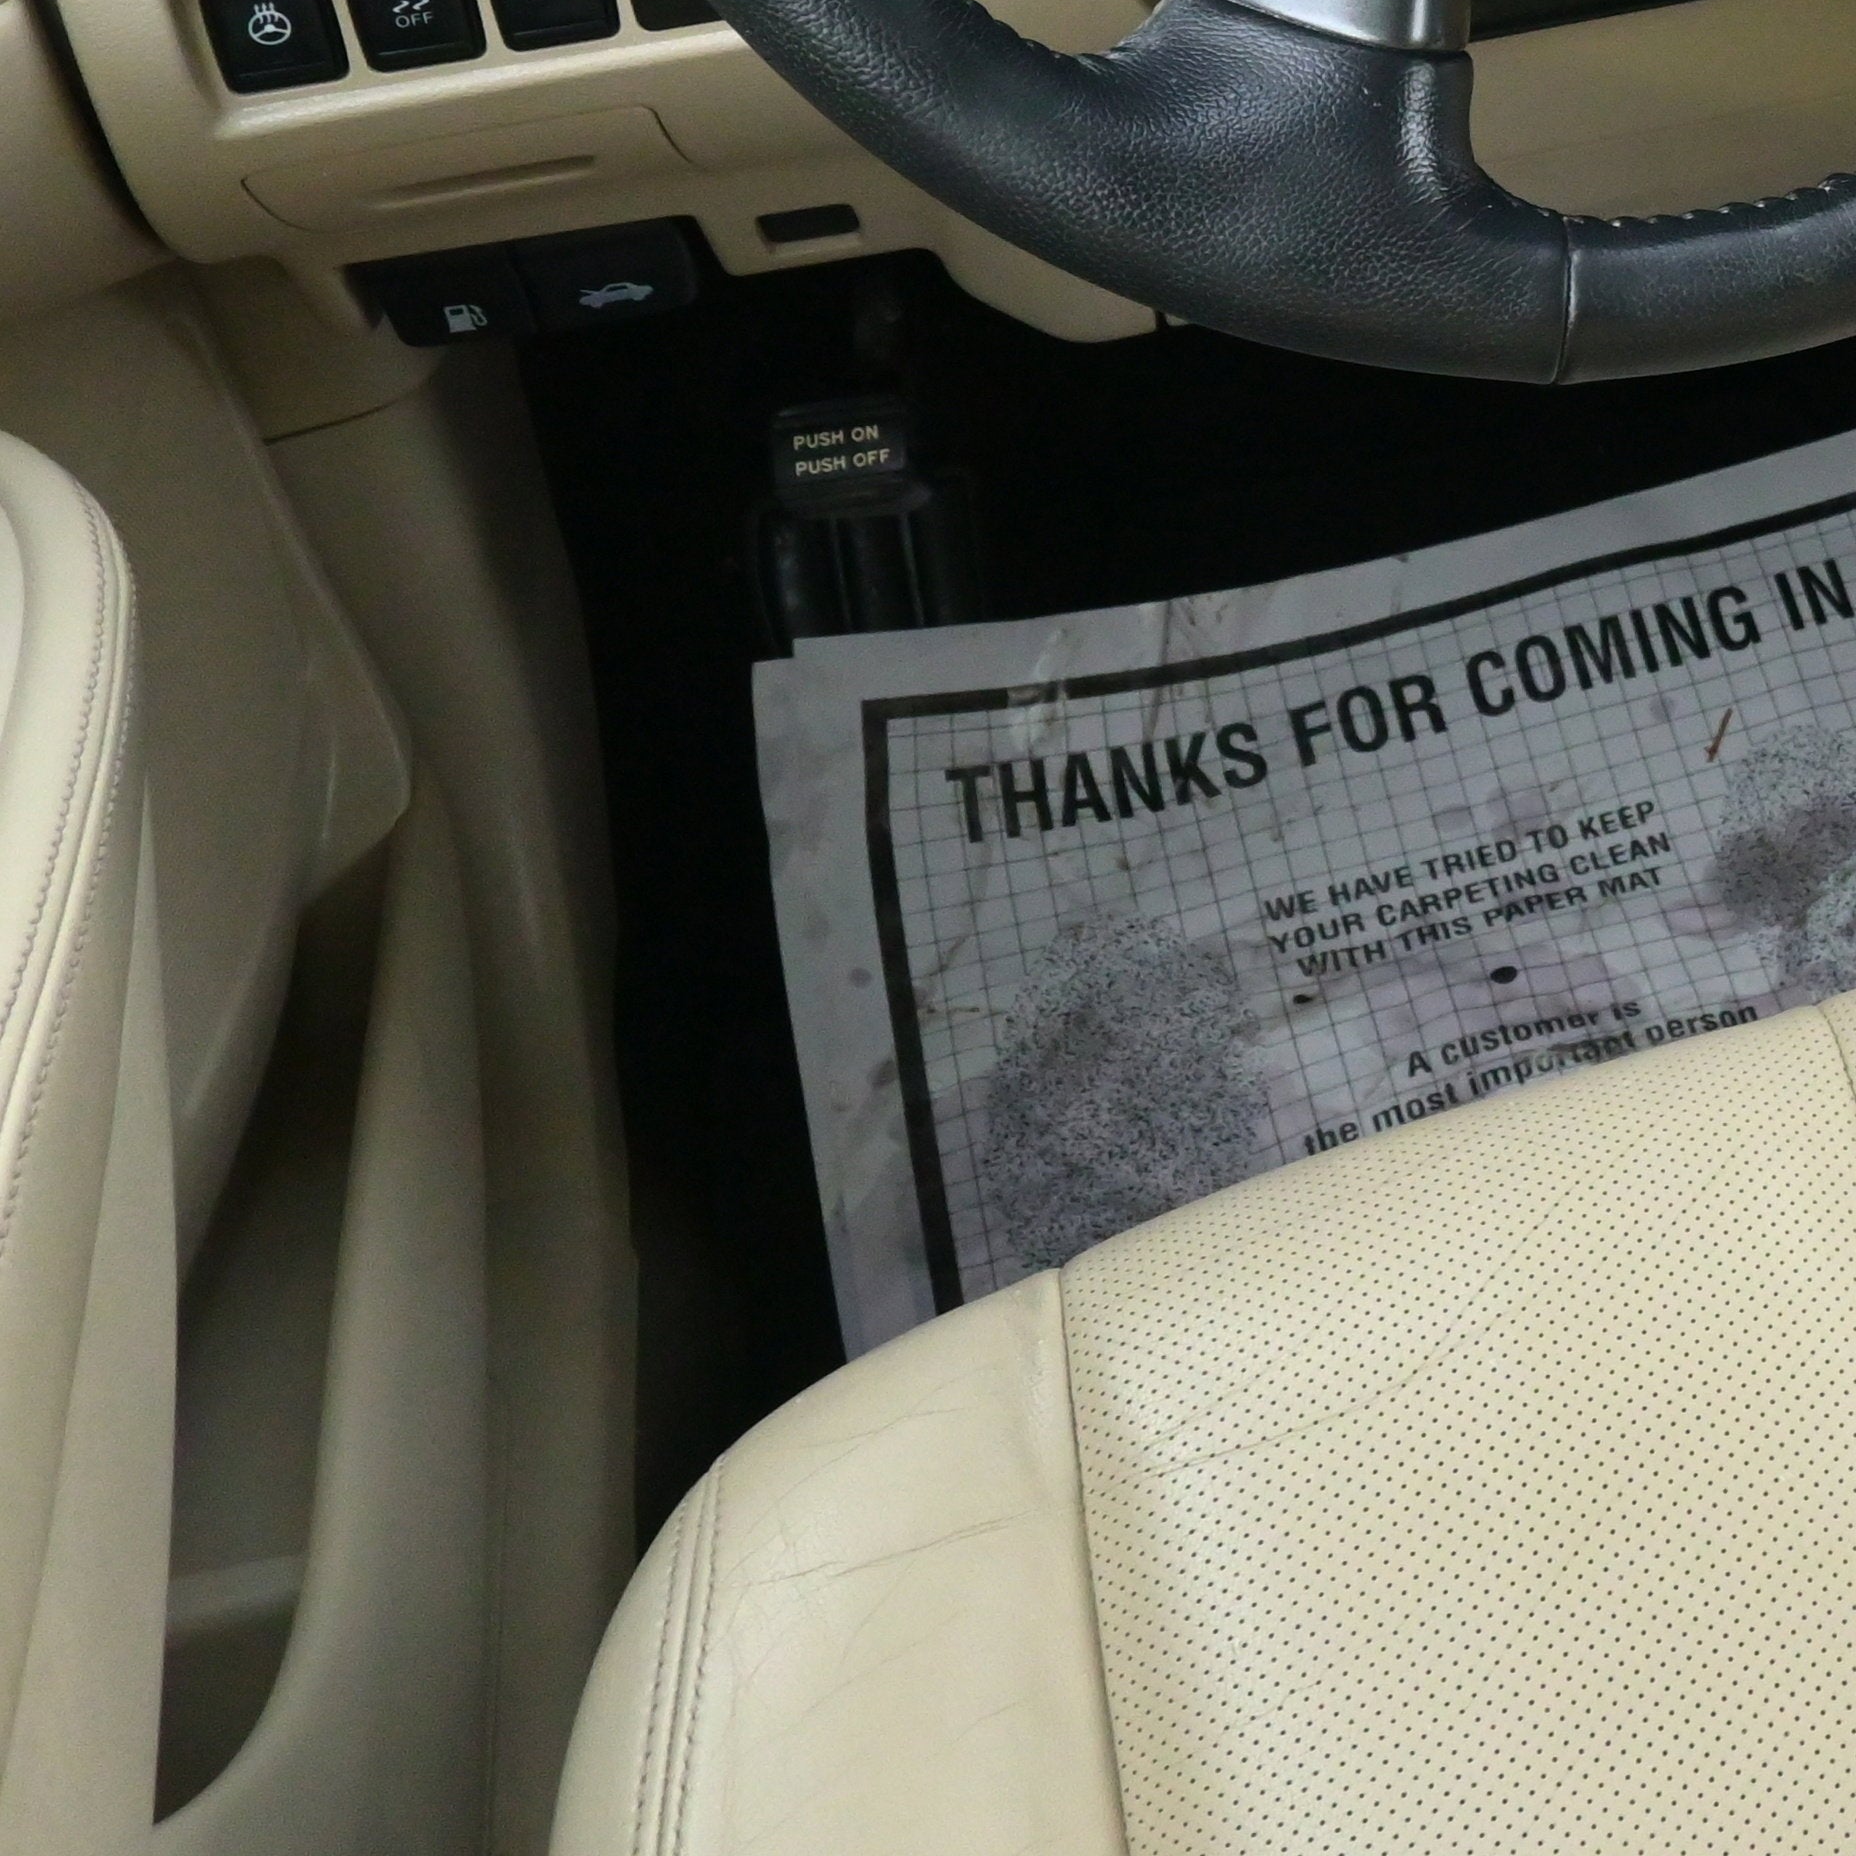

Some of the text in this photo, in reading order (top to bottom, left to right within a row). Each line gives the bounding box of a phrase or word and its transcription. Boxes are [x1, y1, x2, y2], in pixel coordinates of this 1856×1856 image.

[395, 9, 433, 29] OFF
[793, 424, 879, 451] PUSH ON
[795, 448, 890, 477] PUSH OFF
[944, 558, 1856, 844] THANKS FOR COMING IN
[1264, 800, 1656, 922] WE HAVE TRIED TO KEEP
[1267, 831, 1671, 955] YOUR CARPETING CLEAN
[1297, 866, 1664, 978] WITH THIS PAPER MAT
[1303, 1118, 1359, 1157] the
[1371, 1087, 1459, 1134] most
[1645, 1002, 1759, 1044] person
[1407, 998, 1642, 1078] A customer is
